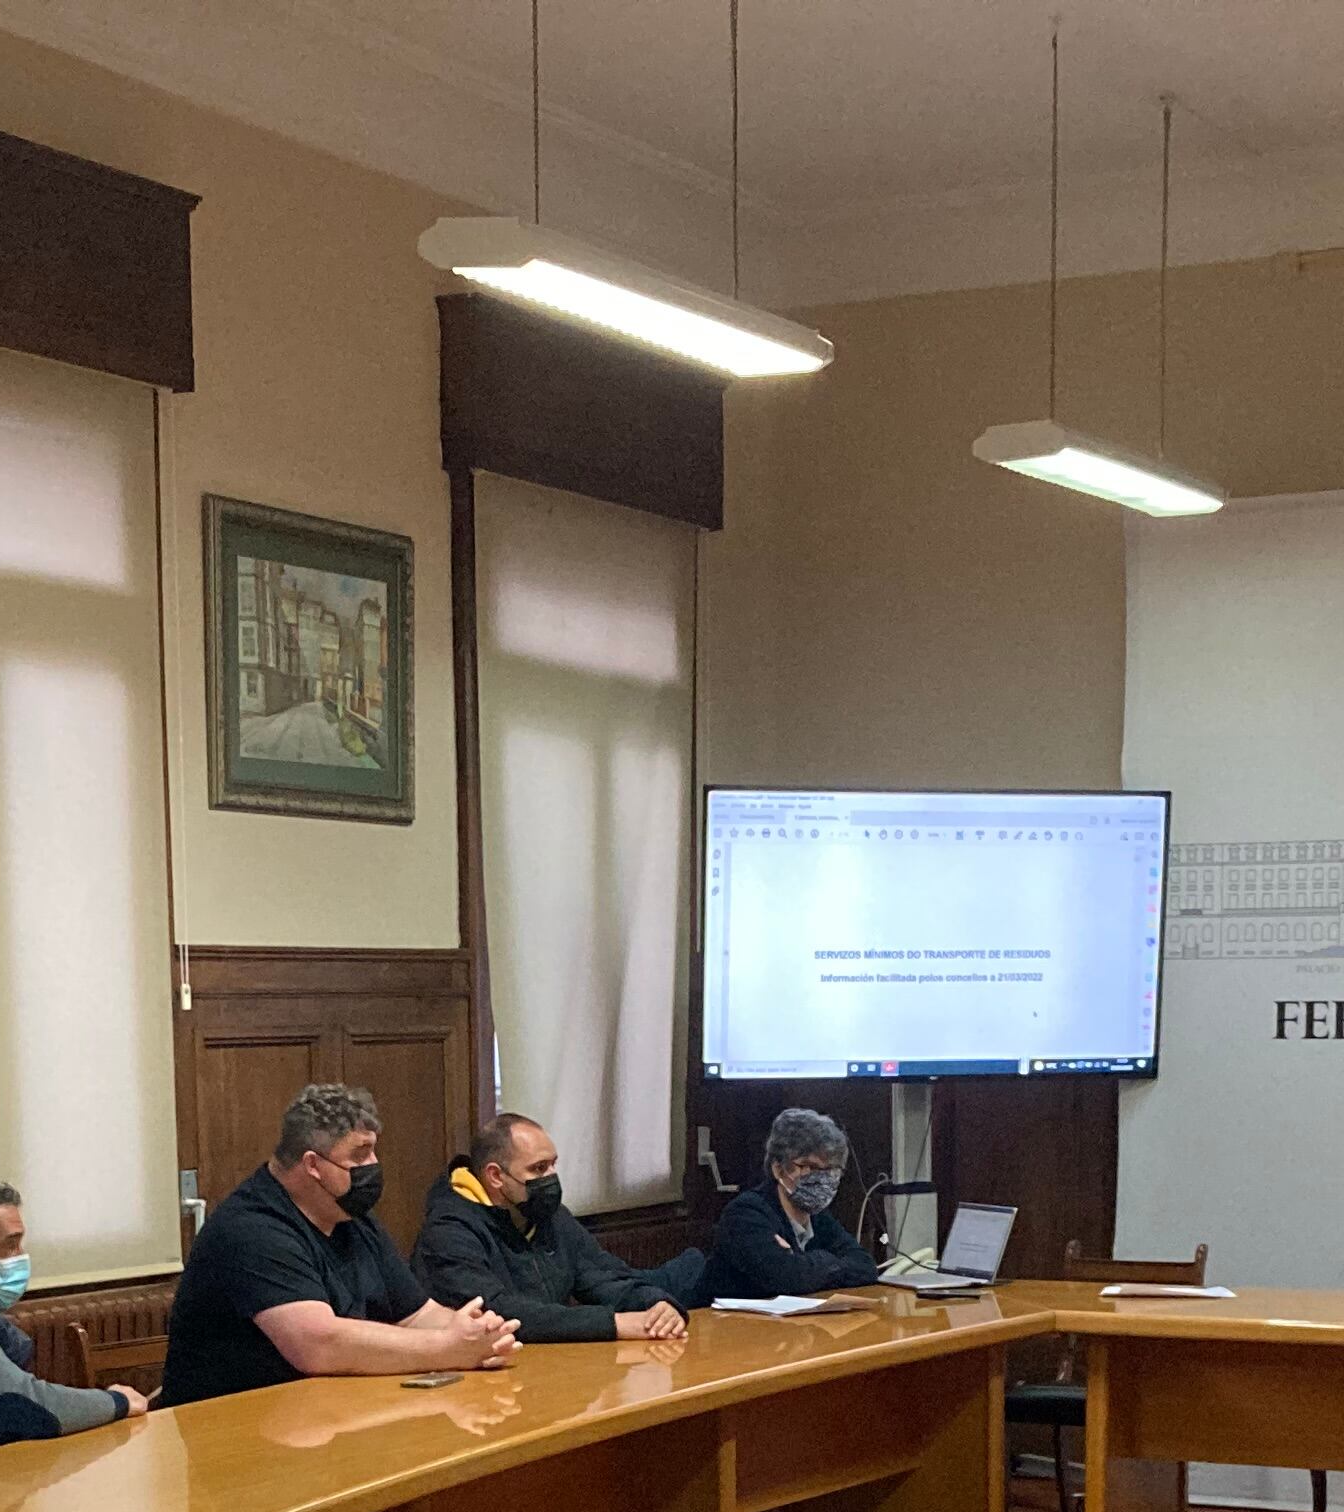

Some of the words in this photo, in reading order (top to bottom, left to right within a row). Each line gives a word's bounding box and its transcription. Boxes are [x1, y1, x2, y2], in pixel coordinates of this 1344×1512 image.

[814, 950, 862, 960] SERVIZOS
[906, 950, 922, 960] DO
[923, 949, 986, 960] TRANSPORTE
[987, 949, 1002, 959] DE
[1003, 949, 1051, 960] RESIDUOS
[820, 973, 875, 983] Información
